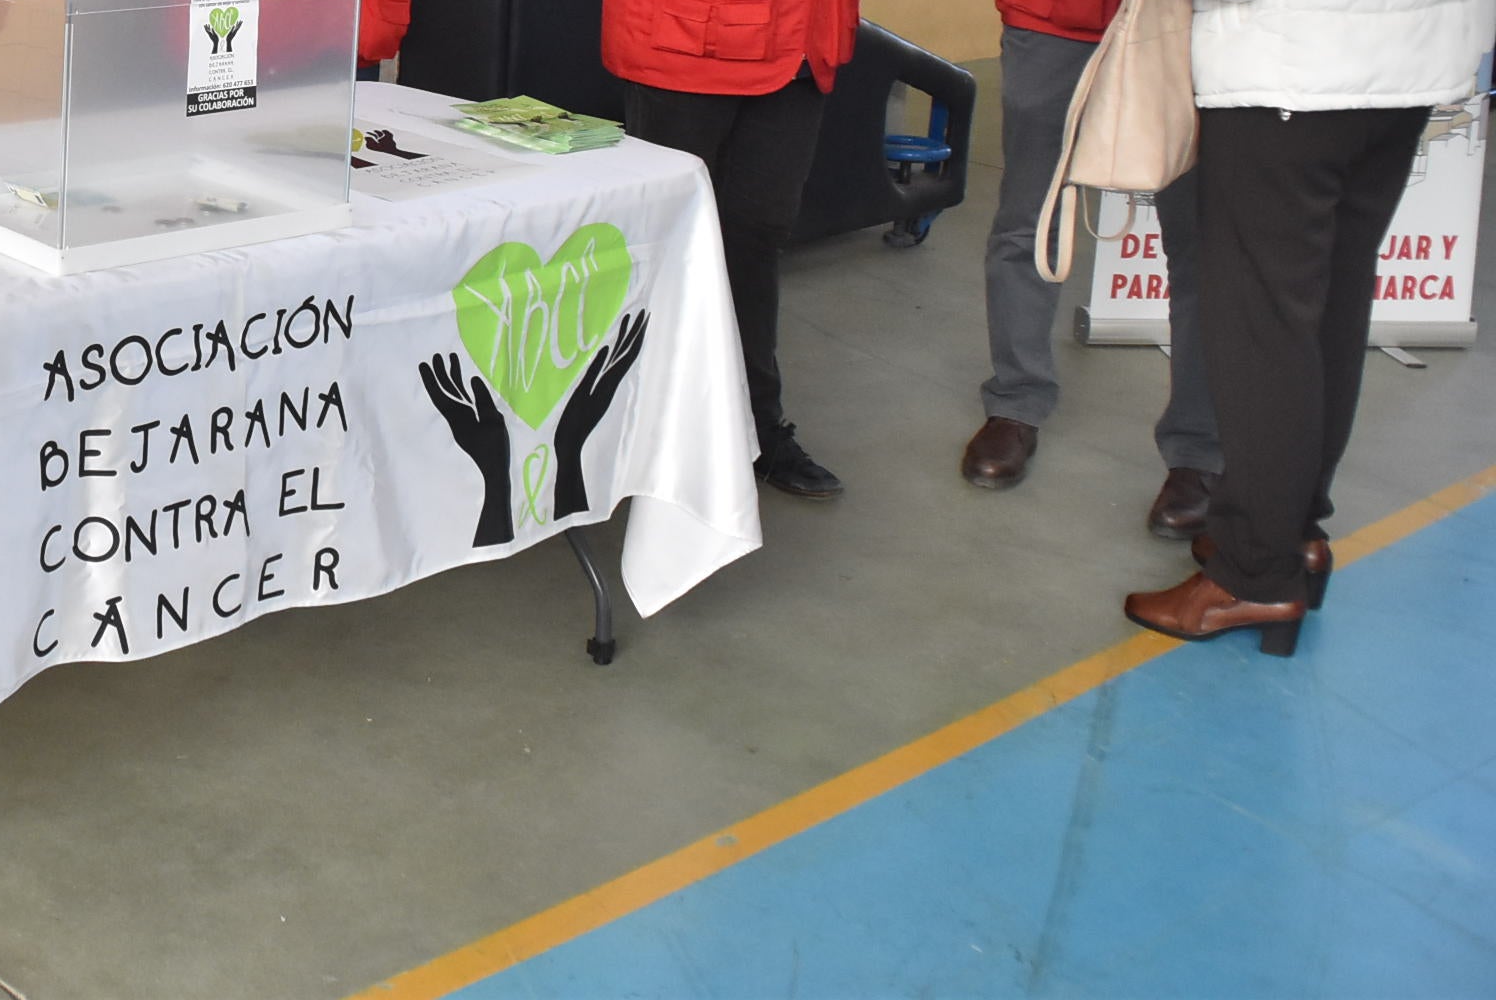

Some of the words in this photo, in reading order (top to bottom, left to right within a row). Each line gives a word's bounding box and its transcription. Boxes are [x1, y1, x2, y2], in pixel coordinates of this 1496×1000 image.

[187, 103, 198, 114] SU
[198, 95, 255, 112] COLABORACIÓN
[197, 90, 229, 102] GRACIAS
[229, 88, 245, 99] POR
[1120, 233, 1160, 259] DE
[1378, 234, 1433, 261] JAR
[1442, 234, 1459, 260] Y
[1372, 274, 1455, 301] ARCA
[42, 294, 355, 402] ASOCIACIÓN
[39, 381, 348, 492] BEJARANA
[39, 489, 250, 572] CONTRA
[278, 466, 346, 517] EL
[33, 546, 340, 658] CÁNCER
